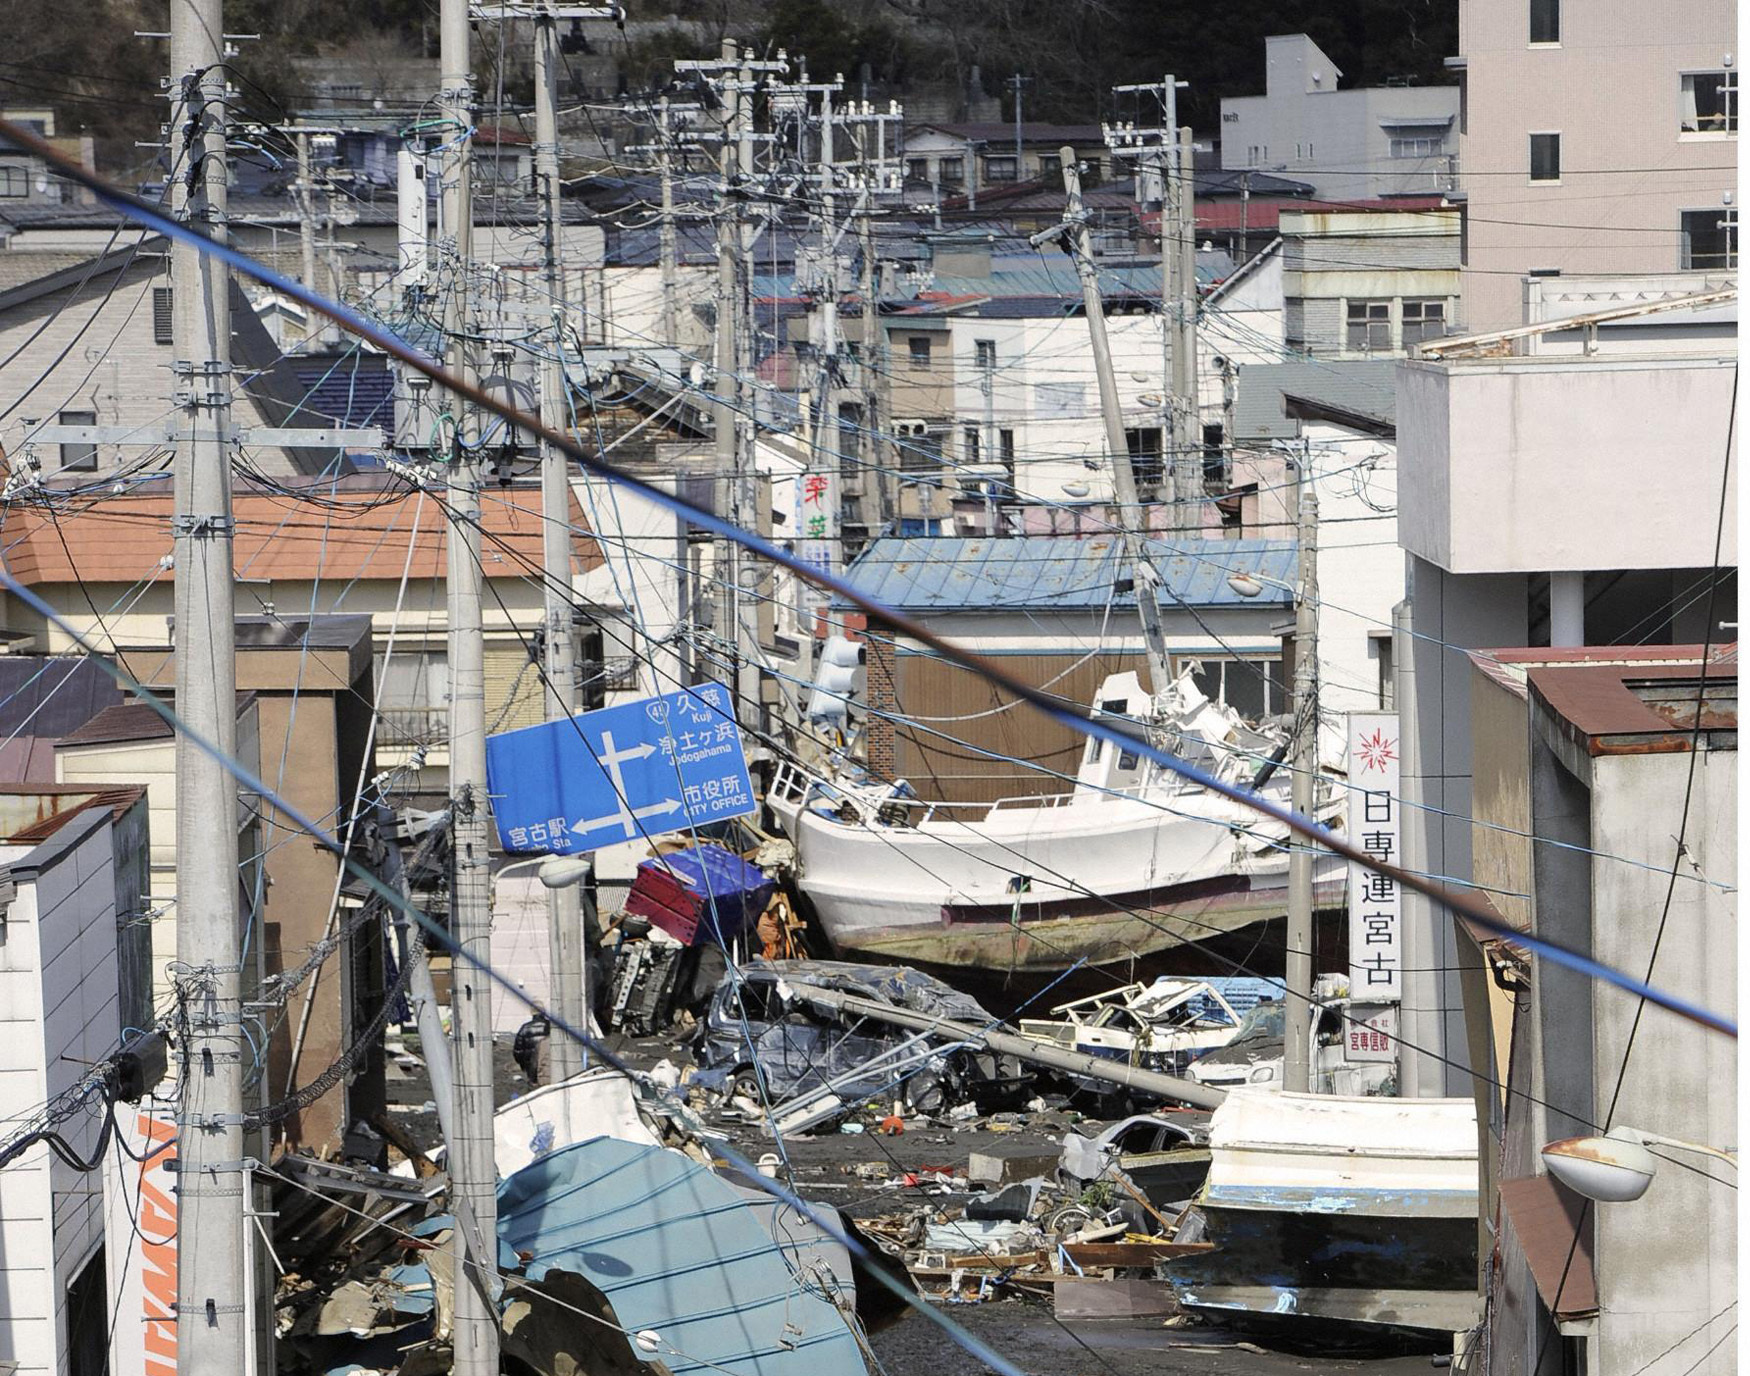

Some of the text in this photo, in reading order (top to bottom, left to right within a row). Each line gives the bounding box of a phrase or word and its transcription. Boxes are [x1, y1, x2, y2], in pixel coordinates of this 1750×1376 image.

[677, 688, 721, 715] 久慈
[691, 710, 713, 724] Kuji
[669, 743, 732, 766] Jodogahama
[683, 774, 740, 804] 市役所
[683, 793, 749, 817] CITY OFFICE
[508, 817, 570, 847] 宮古駅
[1361, 790, 1396, 985] 日専連宮古
